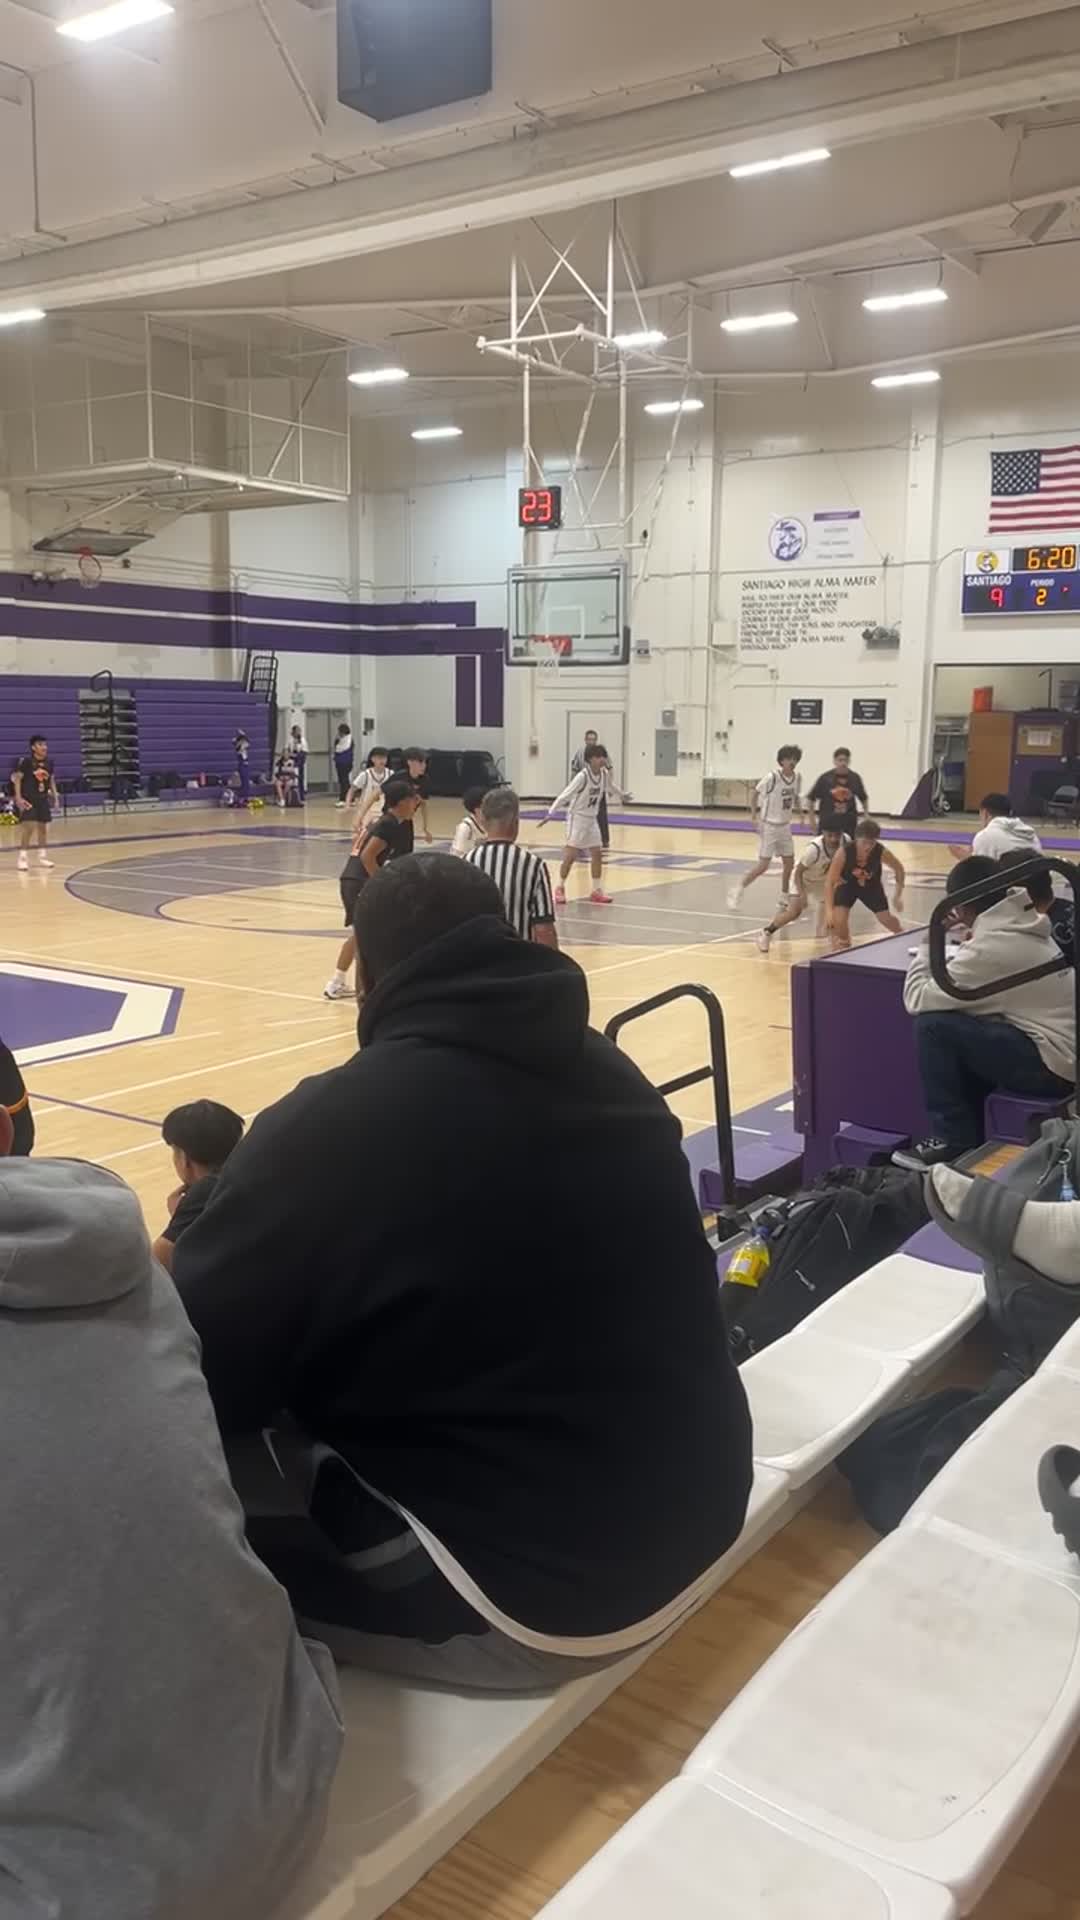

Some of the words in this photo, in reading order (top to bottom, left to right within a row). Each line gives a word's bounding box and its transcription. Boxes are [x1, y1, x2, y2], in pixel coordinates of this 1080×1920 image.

[522, 491, 552, 522] 23
[1028, 546, 1075, 570] 6:20
[742, 579, 785, 591] SANTIAGO
[788, 579, 811, 589] HIGH
[814, 577, 841, 588] ALMA
[843, 575, 877, 587] MATER
[966, 575, 1012, 587] SANTIAGO
[1030, 578, 1055, 587] PERIOD
[991, 586, 1003, 608] 9
[1036, 588, 1047, 606] 2
